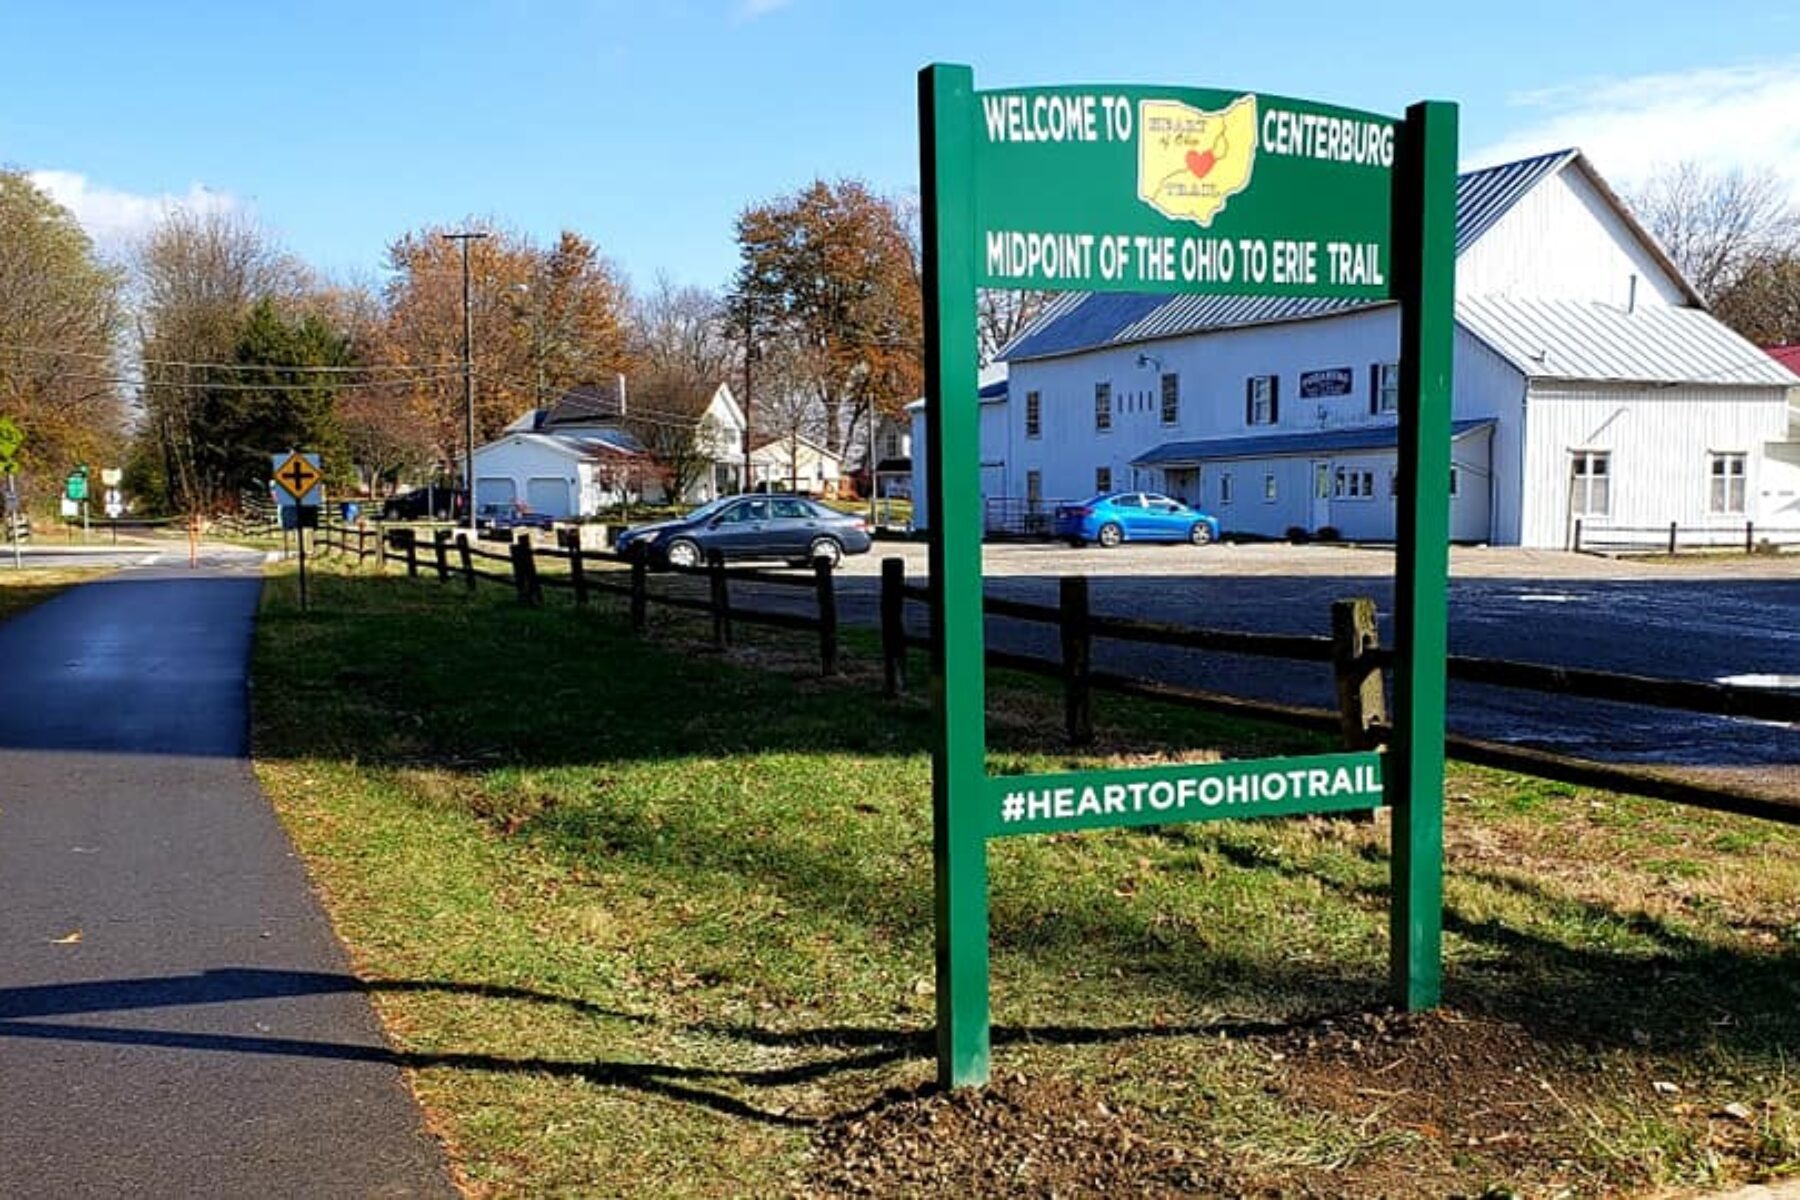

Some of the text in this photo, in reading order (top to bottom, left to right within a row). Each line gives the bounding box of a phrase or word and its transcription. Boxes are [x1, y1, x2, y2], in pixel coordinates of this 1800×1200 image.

[982, 95, 1394, 168] WELCOME TO CENTERBURG
[986, 231, 1384, 286] MIDPOINT OF THE OHIO TO ERIE TRAIL
[1002, 764, 1385, 823] #HEARTOFOHIOTRAIL
